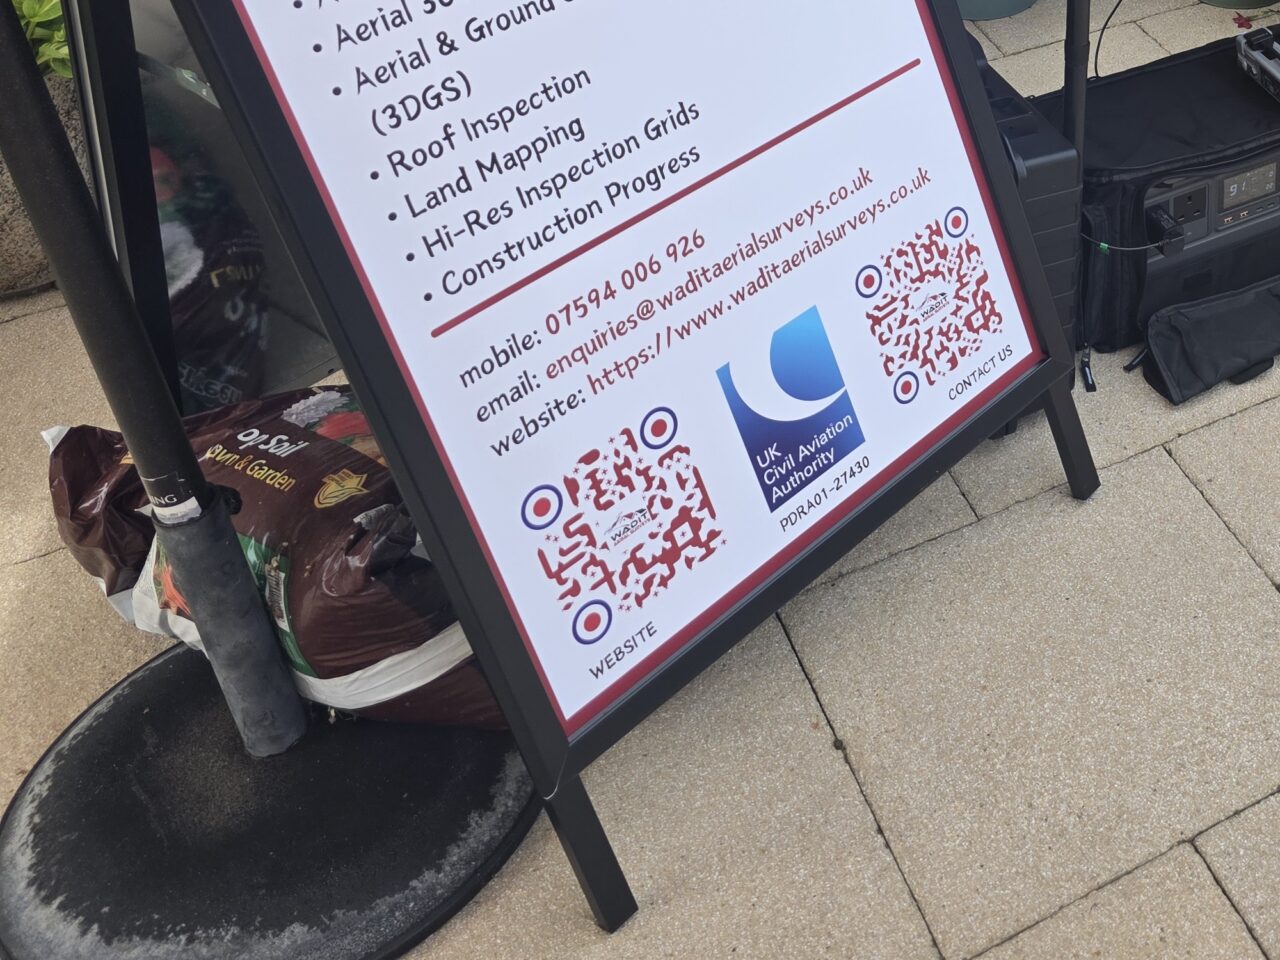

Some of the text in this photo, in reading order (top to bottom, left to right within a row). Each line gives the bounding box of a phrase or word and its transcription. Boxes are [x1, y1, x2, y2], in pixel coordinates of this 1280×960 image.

[355, 38, 431, 94] Aerial
[436, 31, 460, 56] &
[372, 70, 471, 136] (3DGS)
[387, 70, 591, 177] Roof Inspection
[404, 118, 585, 218] Land Mapping
[422, 102, 699, 257] Hi-Res Inspection Grids
[442, 146, 700, 295] Construction Progress
[459, 229, 705, 388] mobile: 07594 006 926
[477, 168, 873, 422] email: enquiries@waditaerialsurveys.co.uk
[490, 167, 931, 456] website: https://www.waditaerialsurveys.co.uk
[949, 345, 1012, 400] CONTACT US
[235, 455, 250, 471] &
[246, 459, 297, 492] Garden
[237, 428, 310, 458] op Soil
[757, 443, 782, 468] UK
[764, 415, 853, 495] Civil Aviation
[771, 447, 835, 504] Authority
[780, 456, 870, 532] PDRA01-27430
[589, 621, 657, 679] WEBSITE
